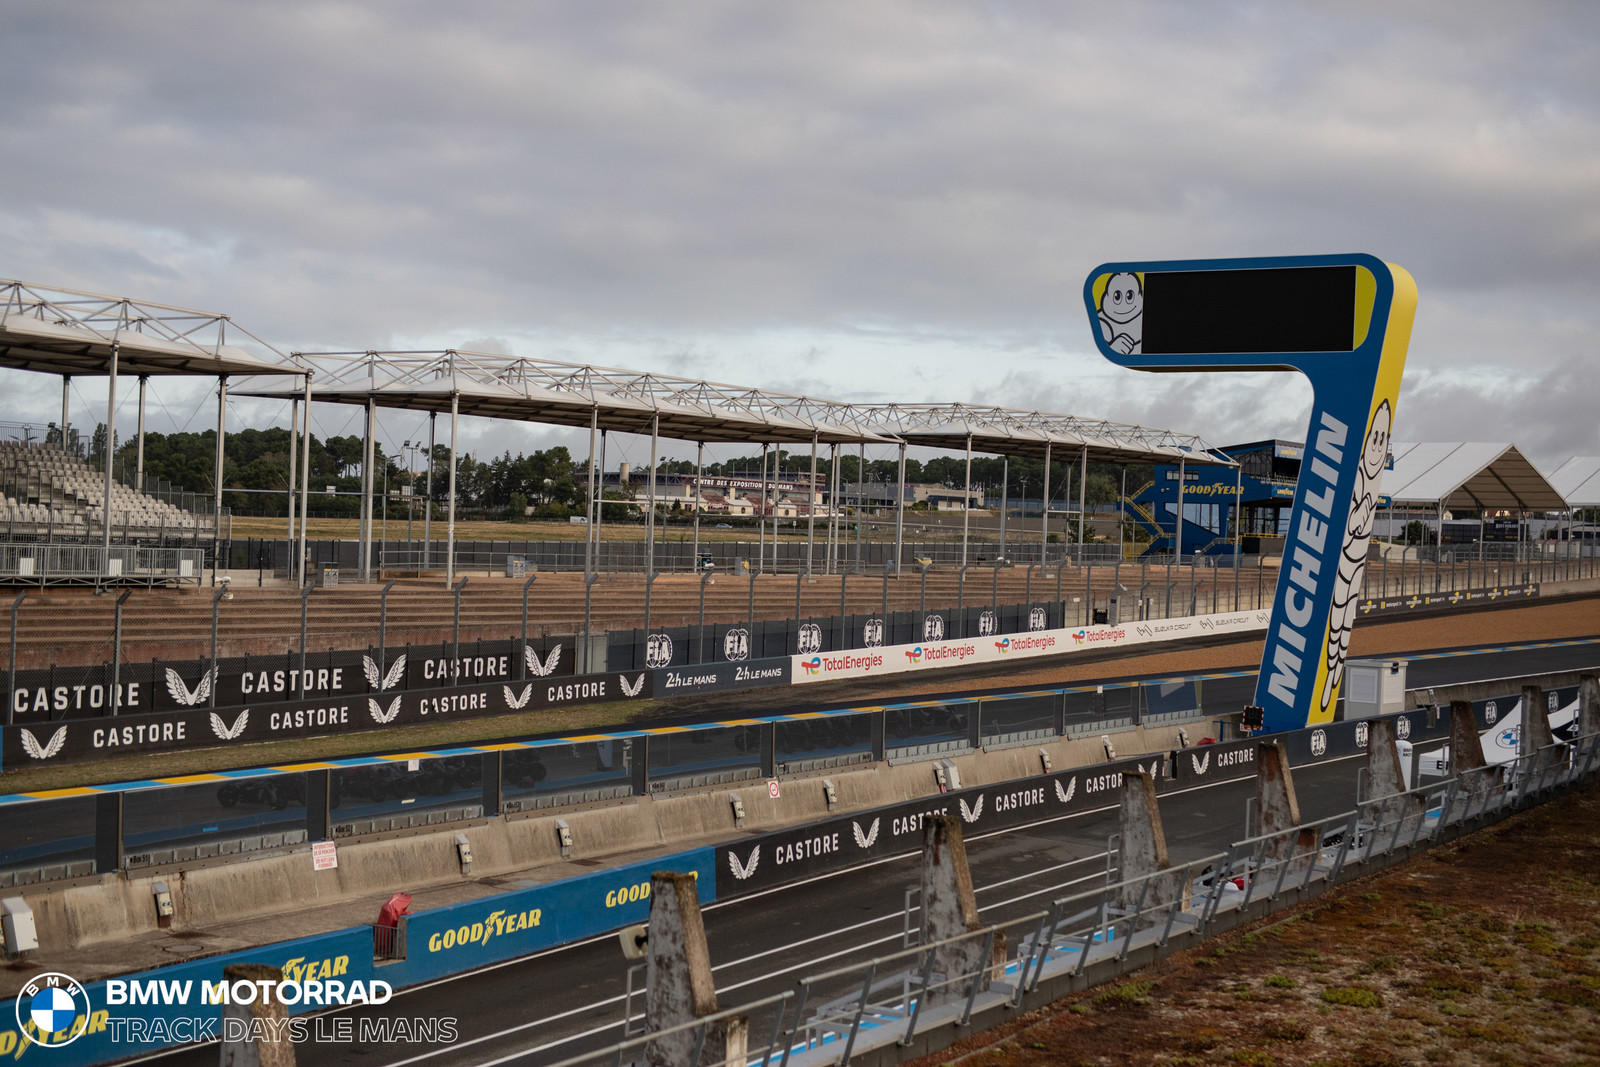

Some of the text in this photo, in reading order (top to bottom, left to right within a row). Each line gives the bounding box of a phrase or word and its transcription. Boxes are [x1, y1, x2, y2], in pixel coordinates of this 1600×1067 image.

[693, 478, 714, 486] CNTRE
[729, 480, 764, 488] EXPOSITION
[1182, 482, 1245, 497] GOODYEAR
[1267, 411, 1349, 709] MICHELIN
[1011, 635, 1056, 651] TotalEnergies
[1085, 628, 1125, 642] TotalEnergies
[823, 653, 883, 671] TotalEnergies
[923, 643, 975, 660] TotalEnergies
[424, 656, 508, 680] CASTORE
[750, 670, 760, 679] LE
[760, 667, 782, 678] MANS
[241, 668, 343, 694] CASTORE
[682, 676, 692, 687] LE
[693, 674, 717, 685] MANS
[547, 681, 606, 702] CASTORE
[420, 692, 487, 715] CASTORE
[270, 706, 349, 730] CASTORE
[93, 722, 186, 748] CASTORE
[1217, 747, 1254, 767] CASTORE
[1086, 772, 1123, 793] CASTOR
[995, 787, 1045, 812] CASTORE
[776, 833, 839, 865] CASTORE
[428, 909, 542, 952] GOODYEAR
